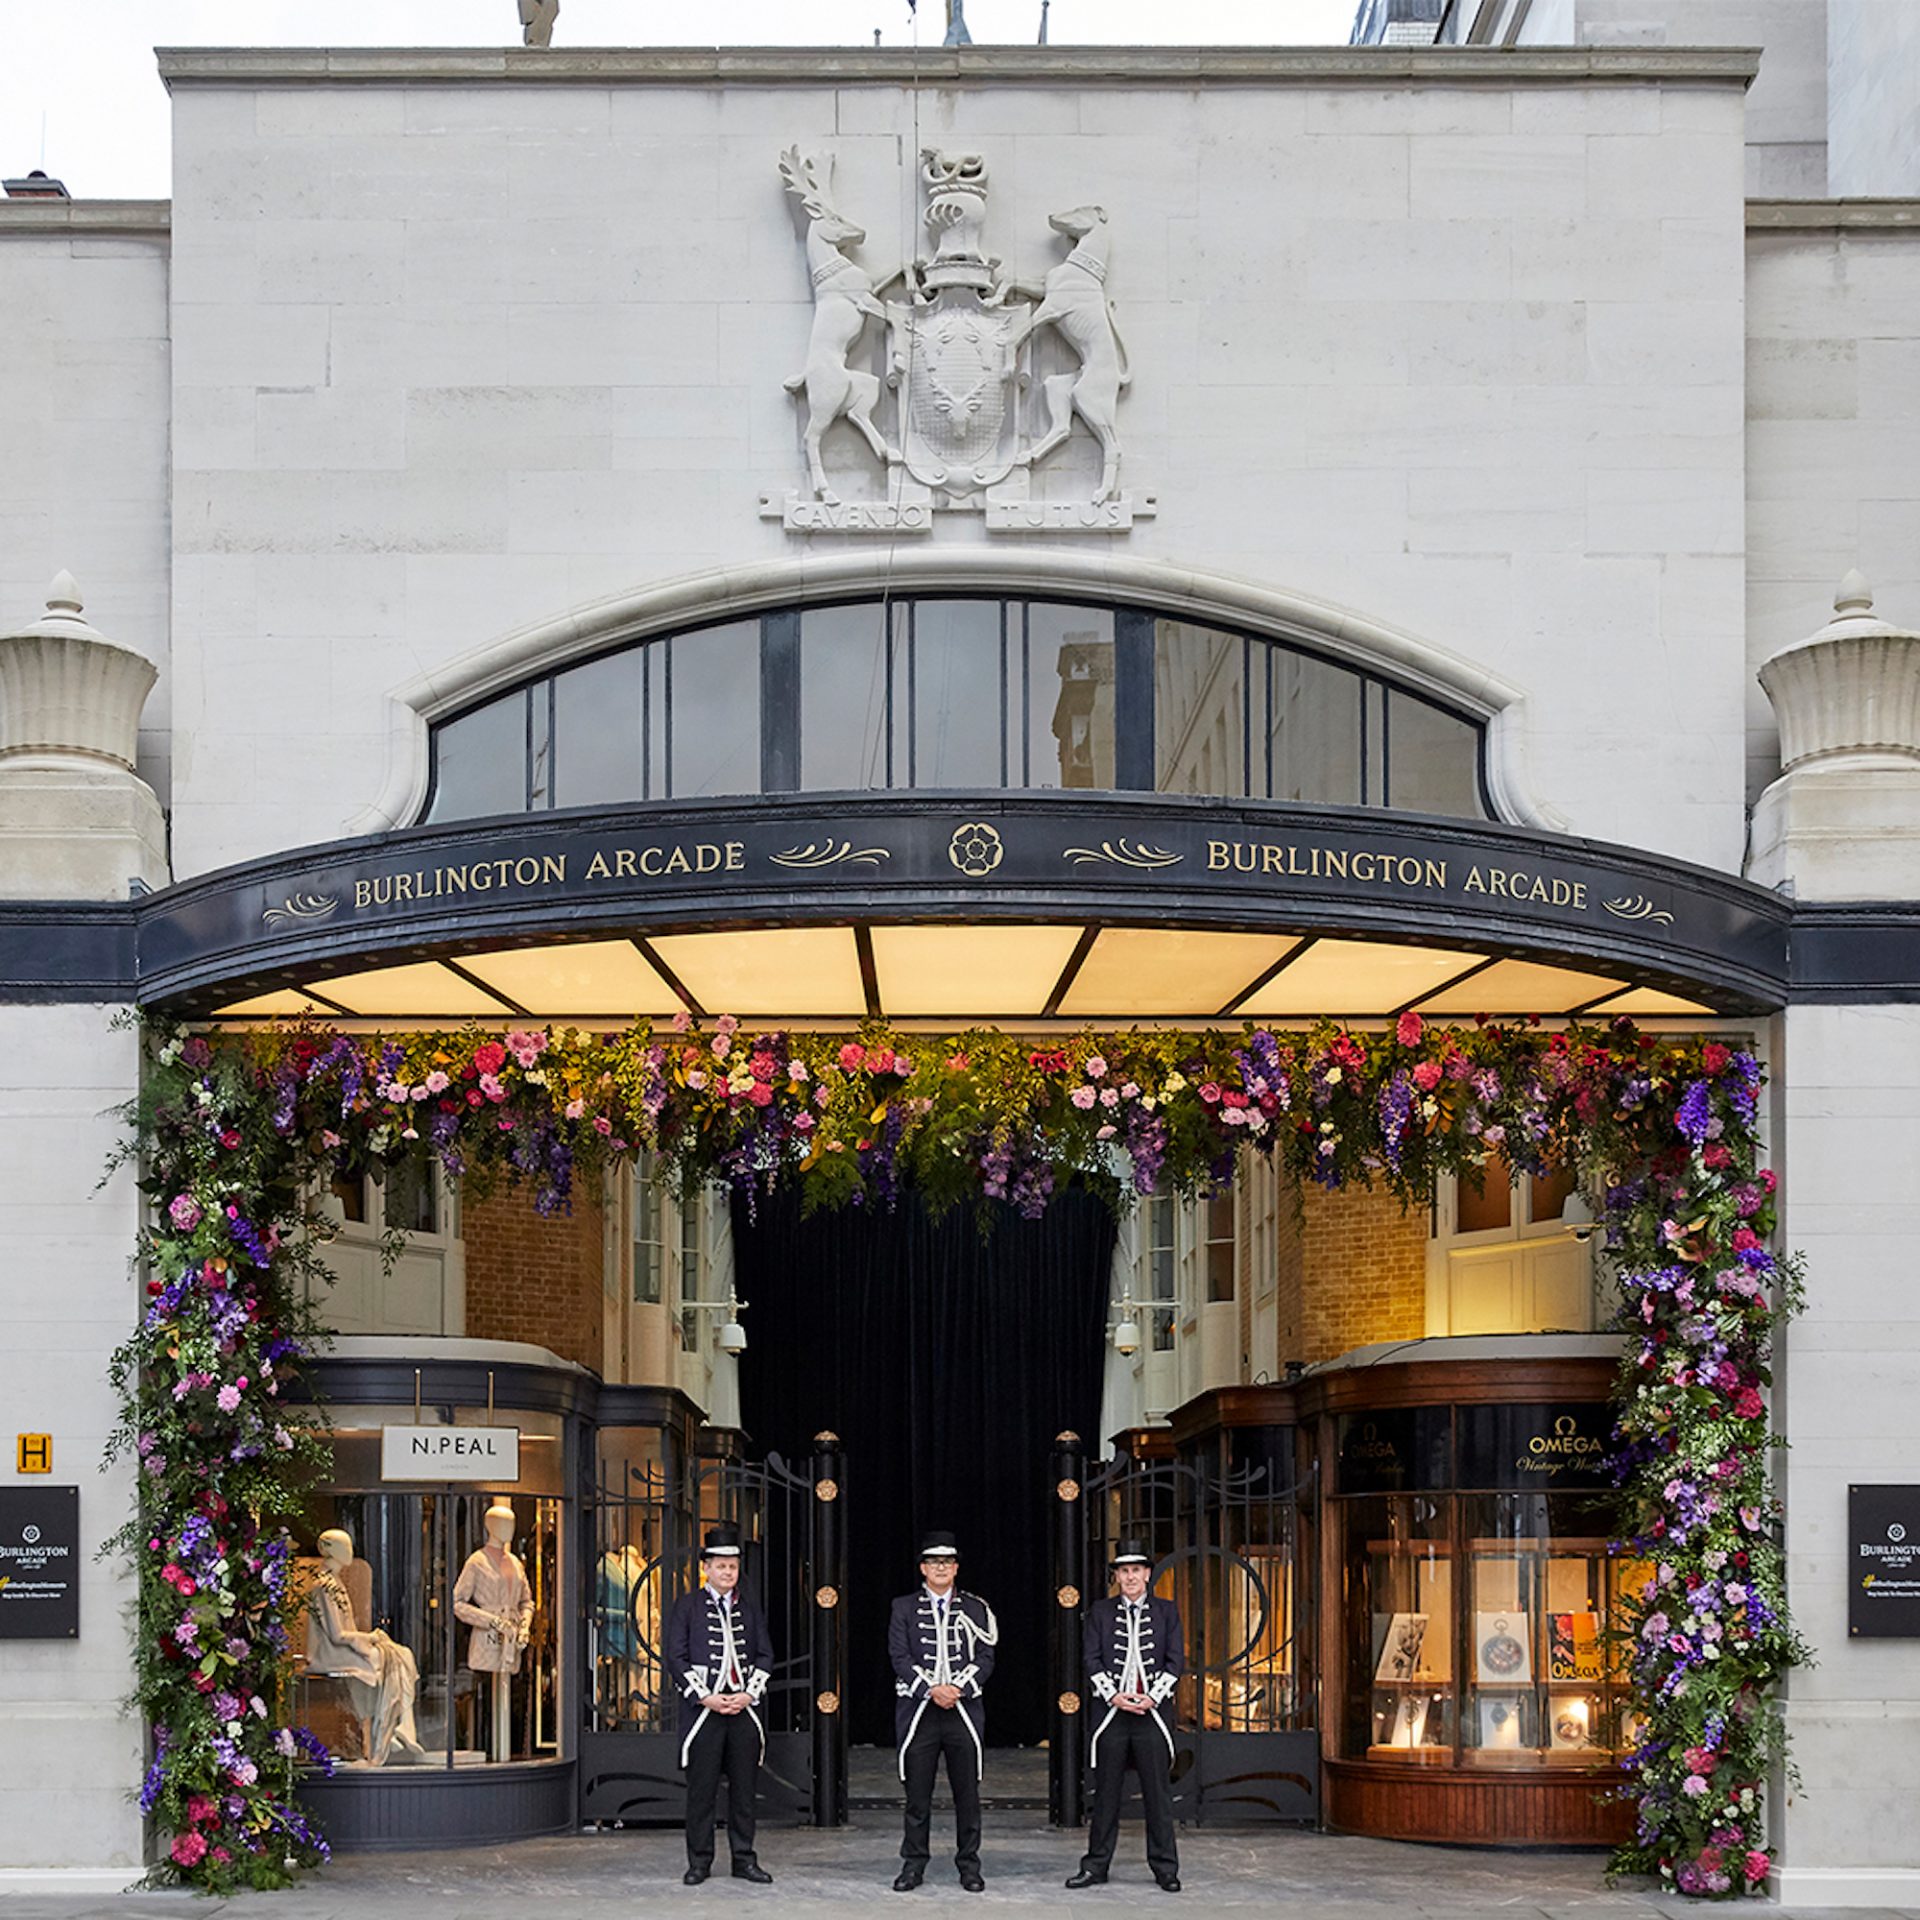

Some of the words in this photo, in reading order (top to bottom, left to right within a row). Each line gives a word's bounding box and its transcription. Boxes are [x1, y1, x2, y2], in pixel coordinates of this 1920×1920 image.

[791, 506, 925, 527] CAVENDO
[1000, 505, 1122, 527] TUTUS
[353, 854, 568, 909] BURLINGTON
[585, 841, 746, 880] ARCADE
[1206, 840, 1448, 889] BURLINGTON
[1464, 865, 1589, 910] ARCADE
[22, 1437, 46, 1468] H
[412, 1437, 497, 1455] N.PEAL
[1529, 1436, 1603, 1454] OMEGA
